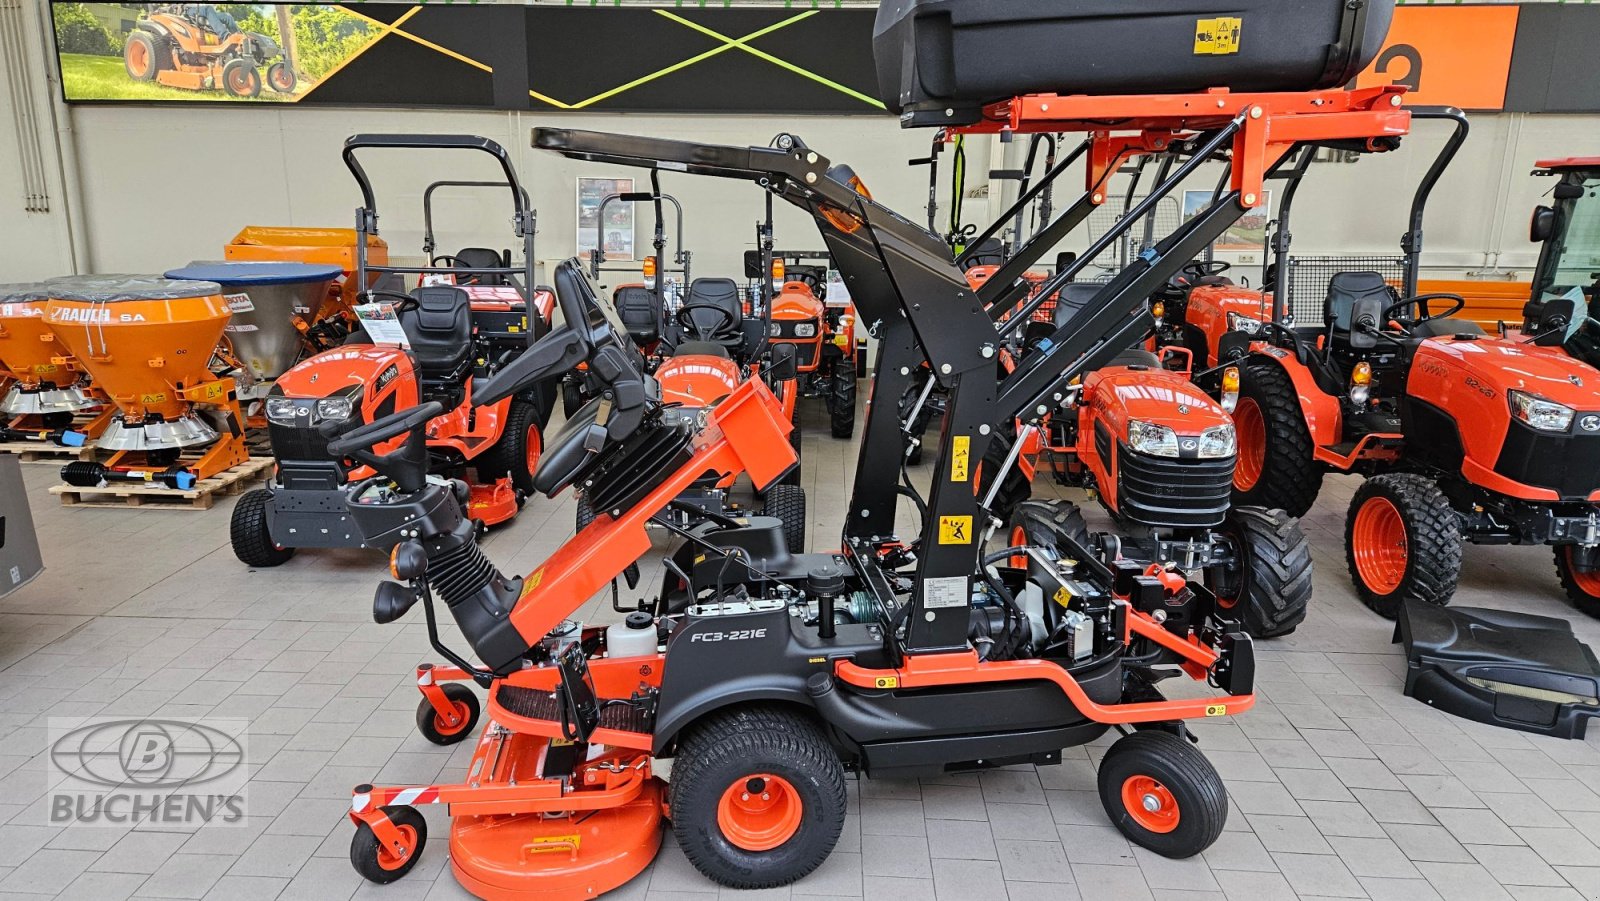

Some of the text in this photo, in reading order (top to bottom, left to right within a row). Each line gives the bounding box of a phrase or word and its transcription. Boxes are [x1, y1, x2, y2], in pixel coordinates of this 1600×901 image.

[61, 307, 111, 322] RAUCH
[120, 314, 146, 322] SA
[690, 628, 767, 642] FC3-221E
